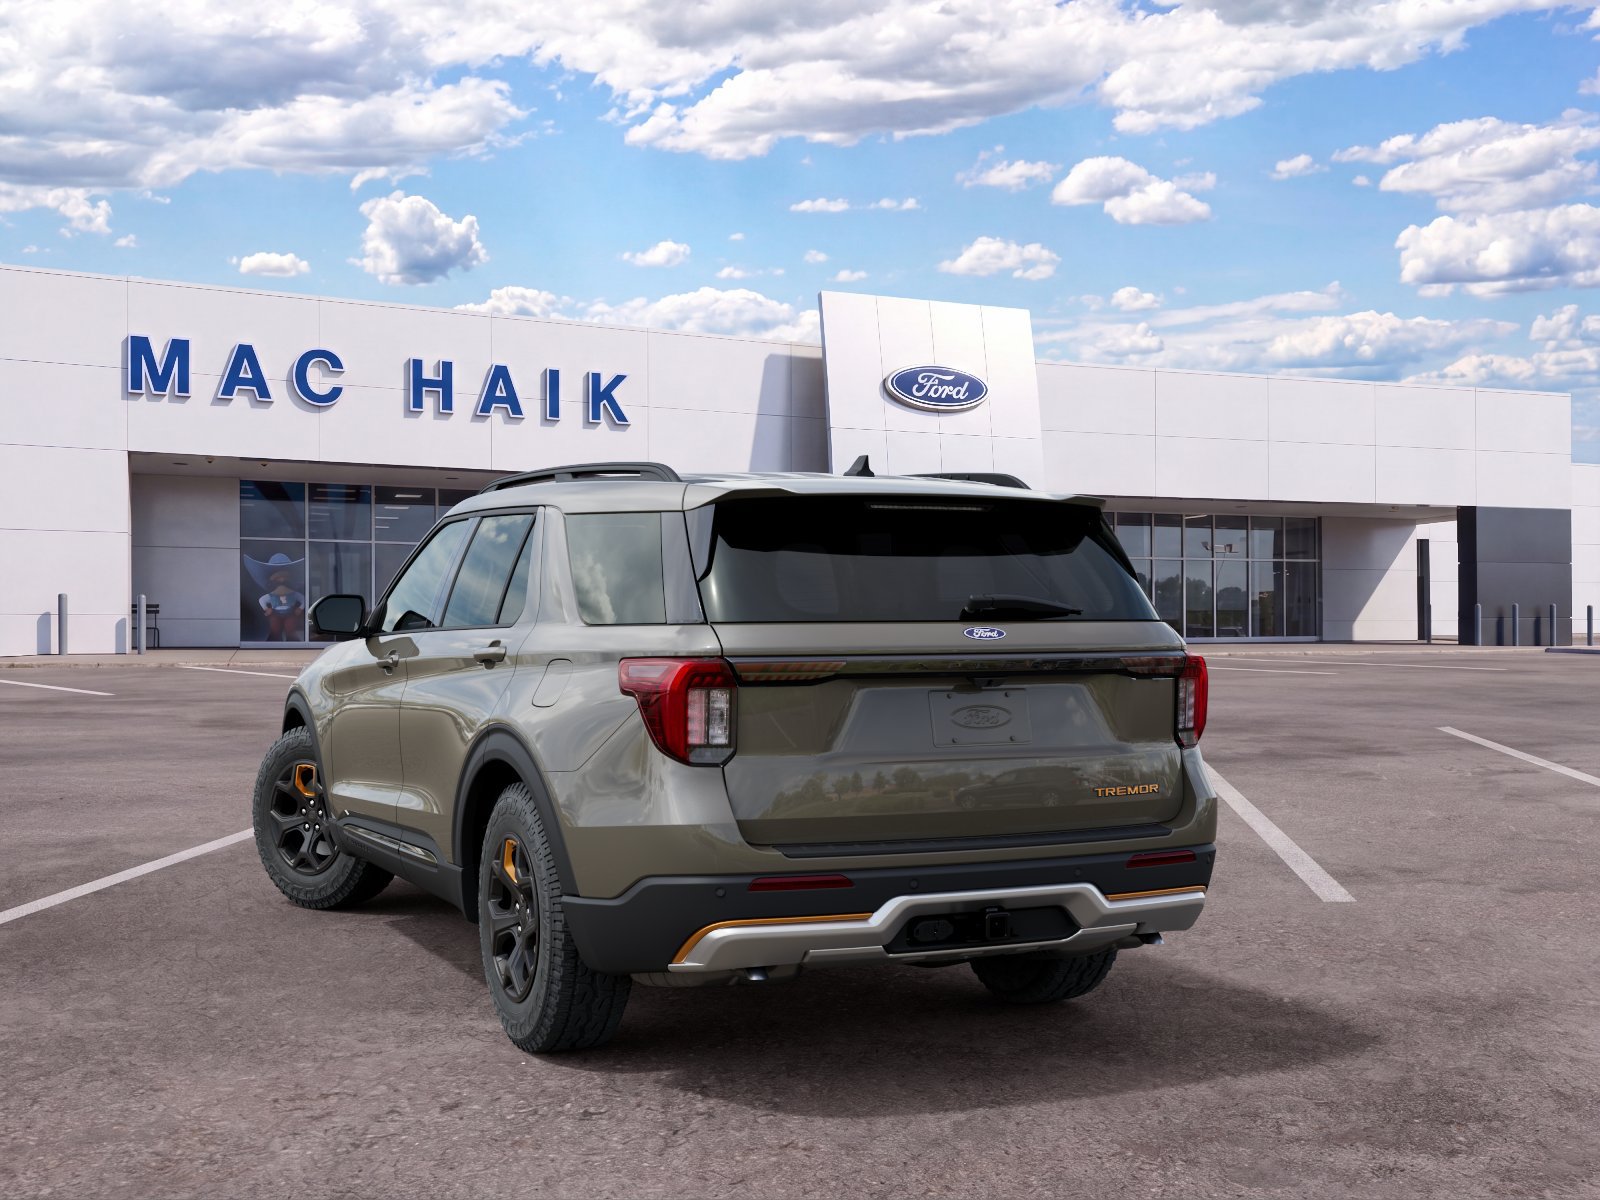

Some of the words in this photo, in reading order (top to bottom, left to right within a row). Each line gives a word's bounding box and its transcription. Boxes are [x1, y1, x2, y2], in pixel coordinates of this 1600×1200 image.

[128, 333, 346, 407] MAC
[409, 357, 632, 426] HAIK
[911, 372, 969, 400] Ford
[973, 628, 998, 638] Ford
[1094, 783, 1160, 797] TREMOR
